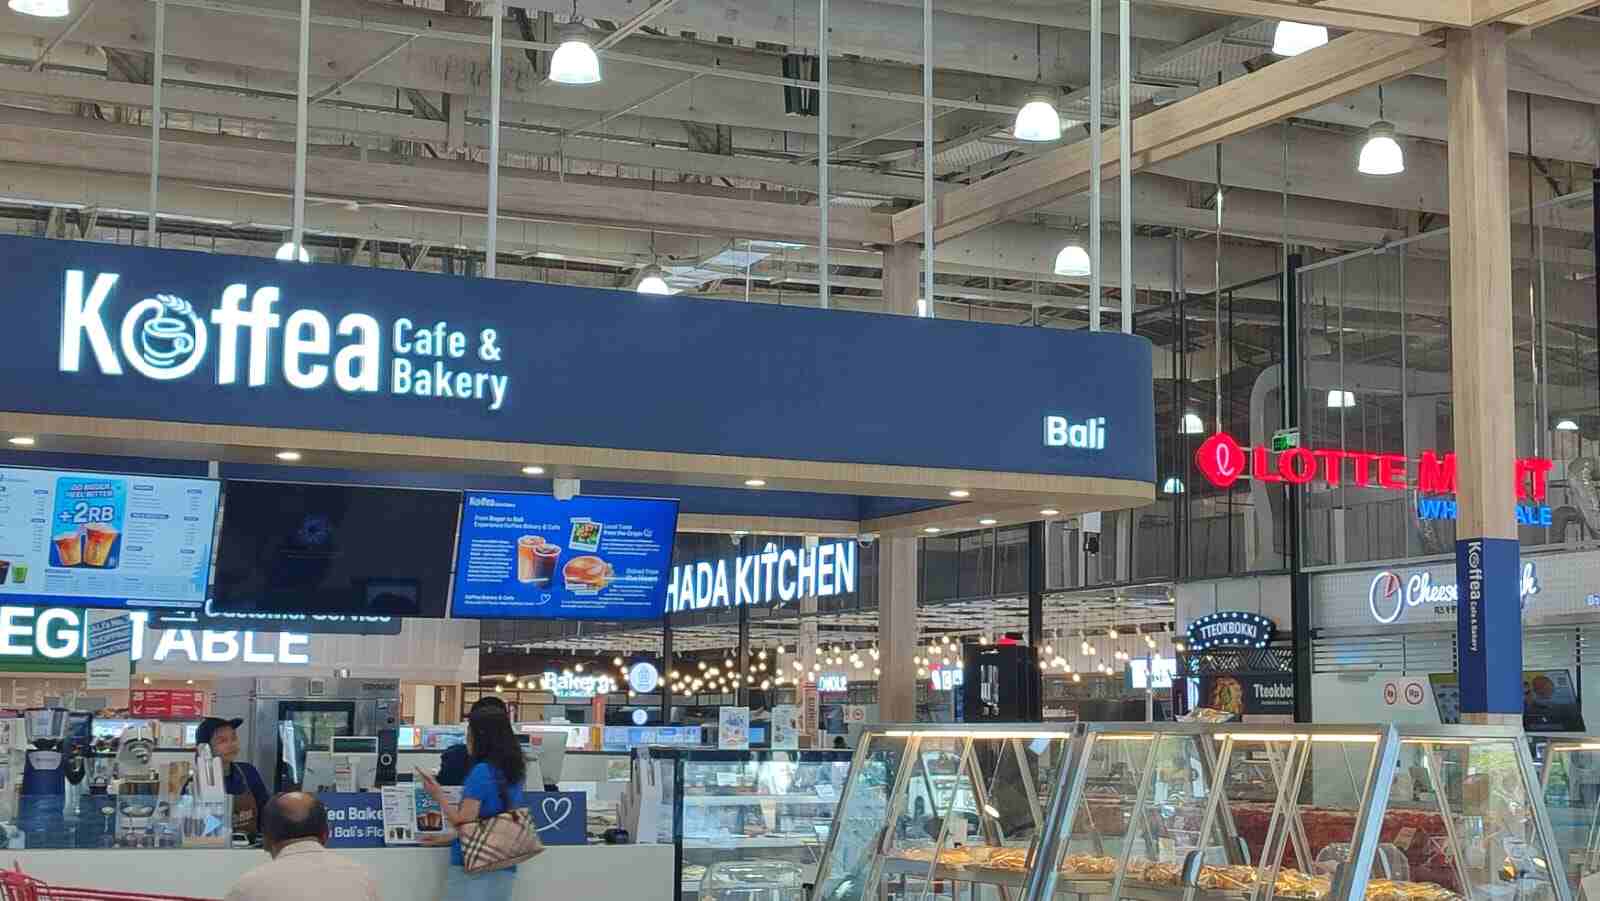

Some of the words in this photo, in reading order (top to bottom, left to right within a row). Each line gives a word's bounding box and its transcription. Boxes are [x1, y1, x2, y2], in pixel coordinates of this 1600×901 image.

[59, 268, 380, 392] Koffea
[393, 316, 466, 358] Cafe
[478, 328, 502, 362] &
[392, 357, 508, 410] Bakery
[1043, 414, 1106, 450] Bali
[1253, 446, 1407, 489] LOTTE
[1419, 451, 1553, 502] MT
[59, 502, 114, 523] +2RB
[1419, 498, 1553, 528] WHALE
[735, 541, 855, 606] KITCHEN
[1468, 541, 1482, 600] Koffea
[0, 606, 309, 663] EGTABLE
[1200, 621, 1257, 639] TTEOKBOKKI
[335, 825, 364, 838] Bali's
